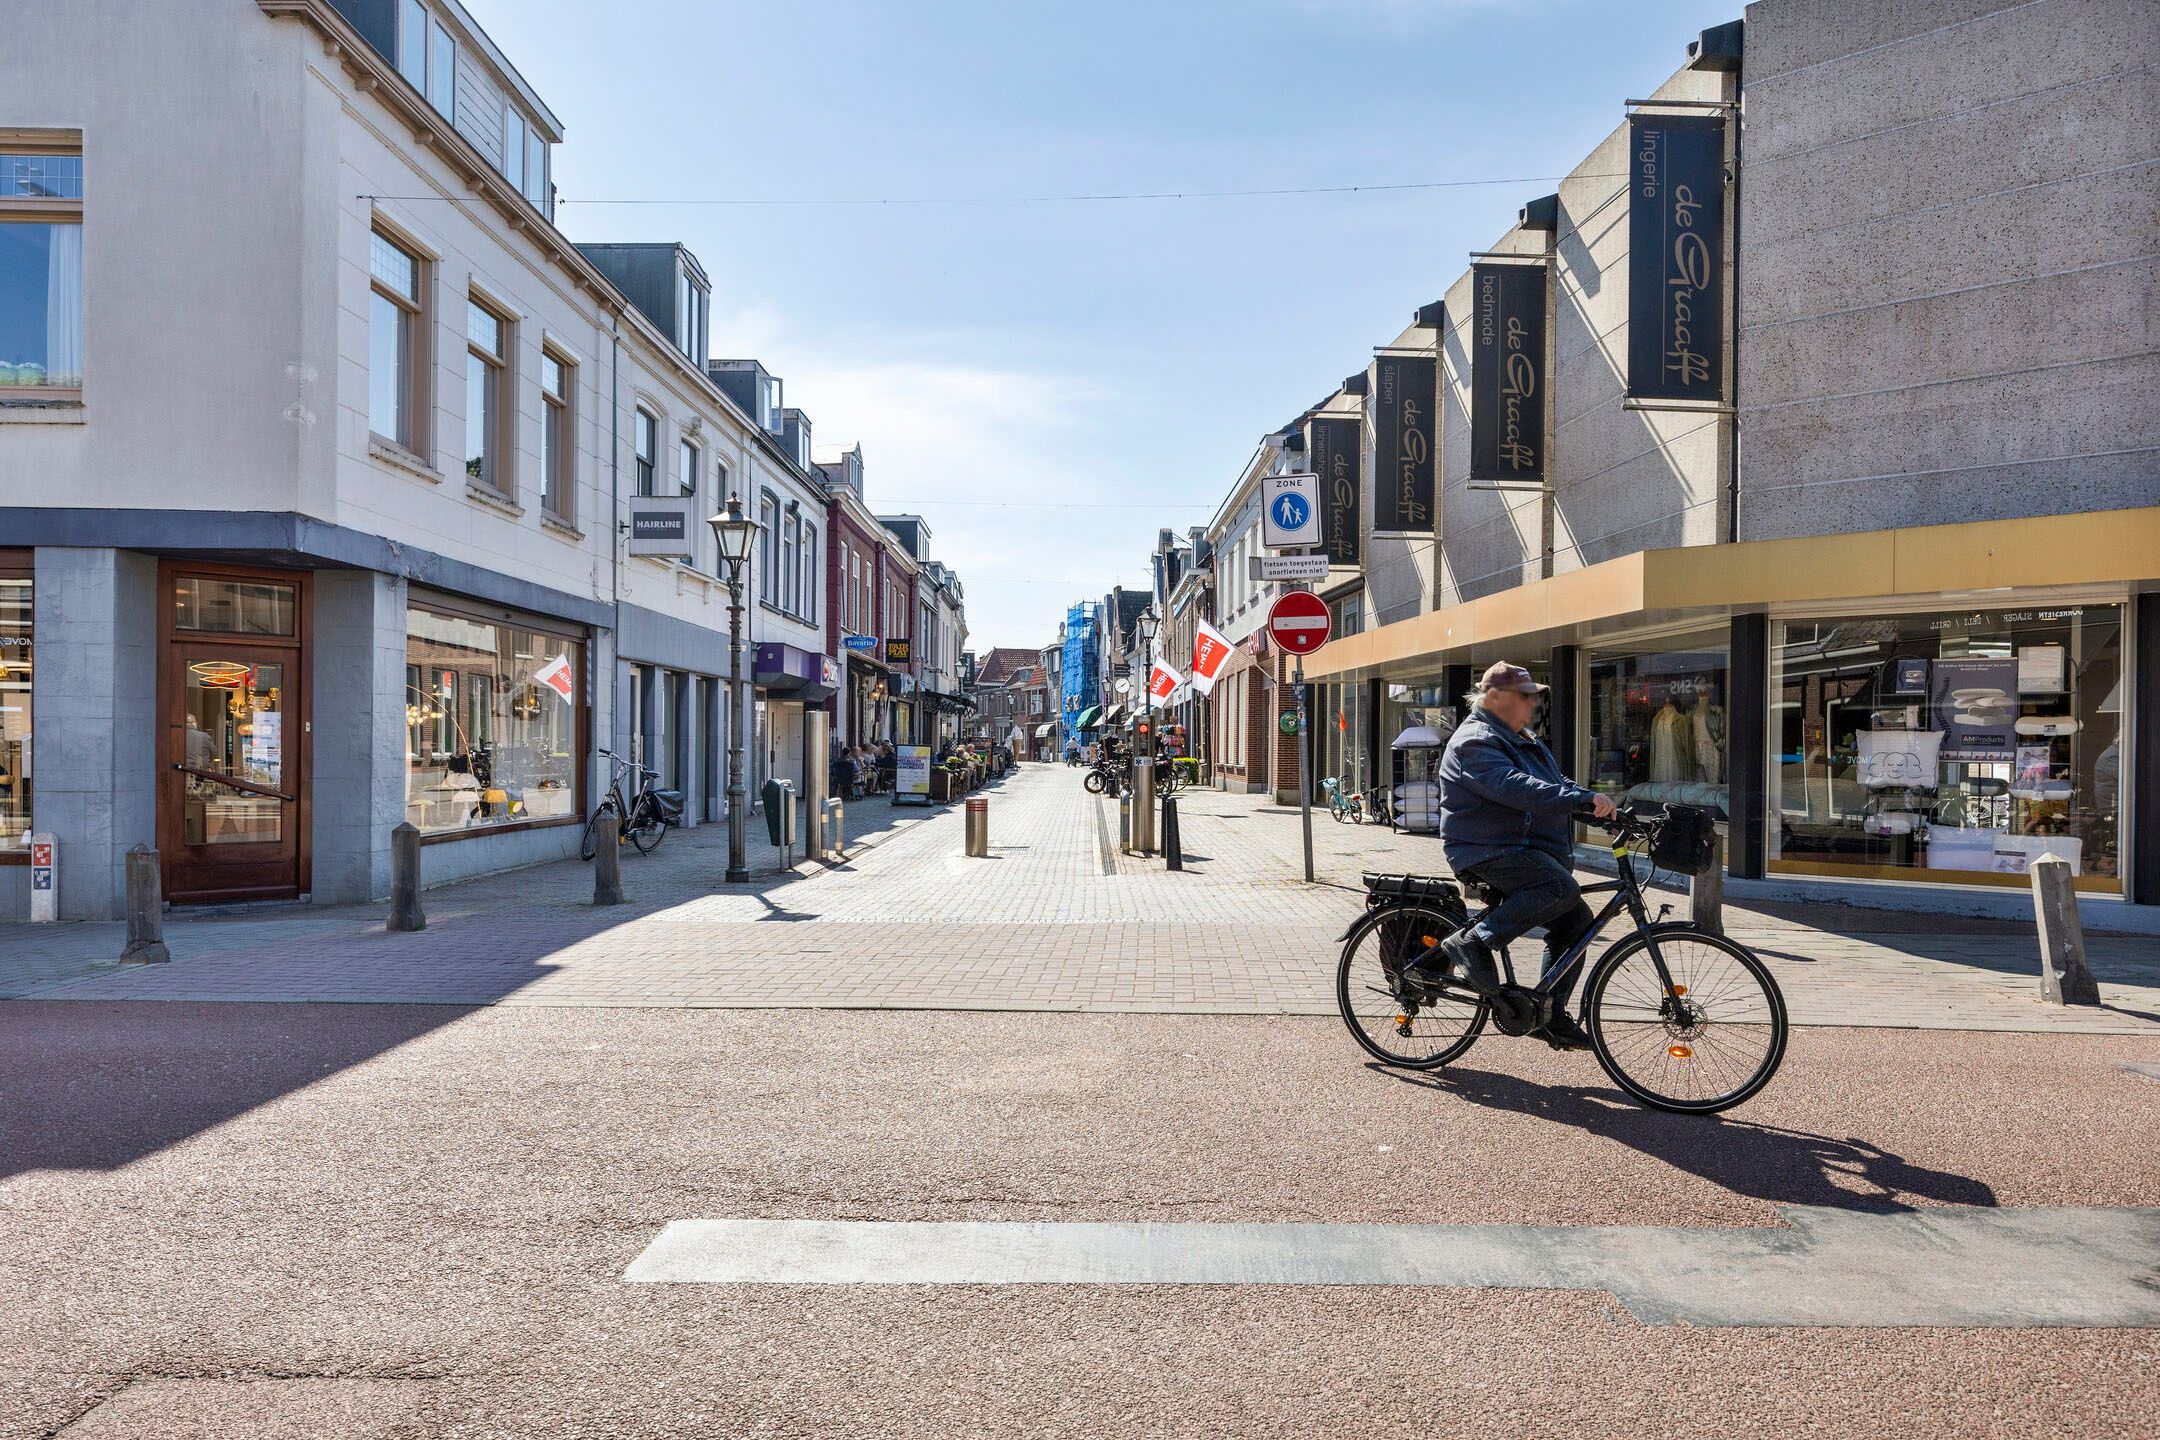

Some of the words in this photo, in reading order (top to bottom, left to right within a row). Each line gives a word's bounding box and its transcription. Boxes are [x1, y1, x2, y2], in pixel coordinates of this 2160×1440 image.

[1639, 131, 1660, 199] lingerie
[1482, 275, 1496, 346] bedmode
[1382, 365, 1394, 404] slapen
[1317, 425, 1328, 480] linnenshop
[1276, 479, 1303, 488] ZONE
[636, 520, 681, 529] HAIRLINE
[1289, 559, 1327, 568] toegestaan
[1268, 568, 1308, 576] snorfietsen
[847, 639, 873, 647] Bavaria
